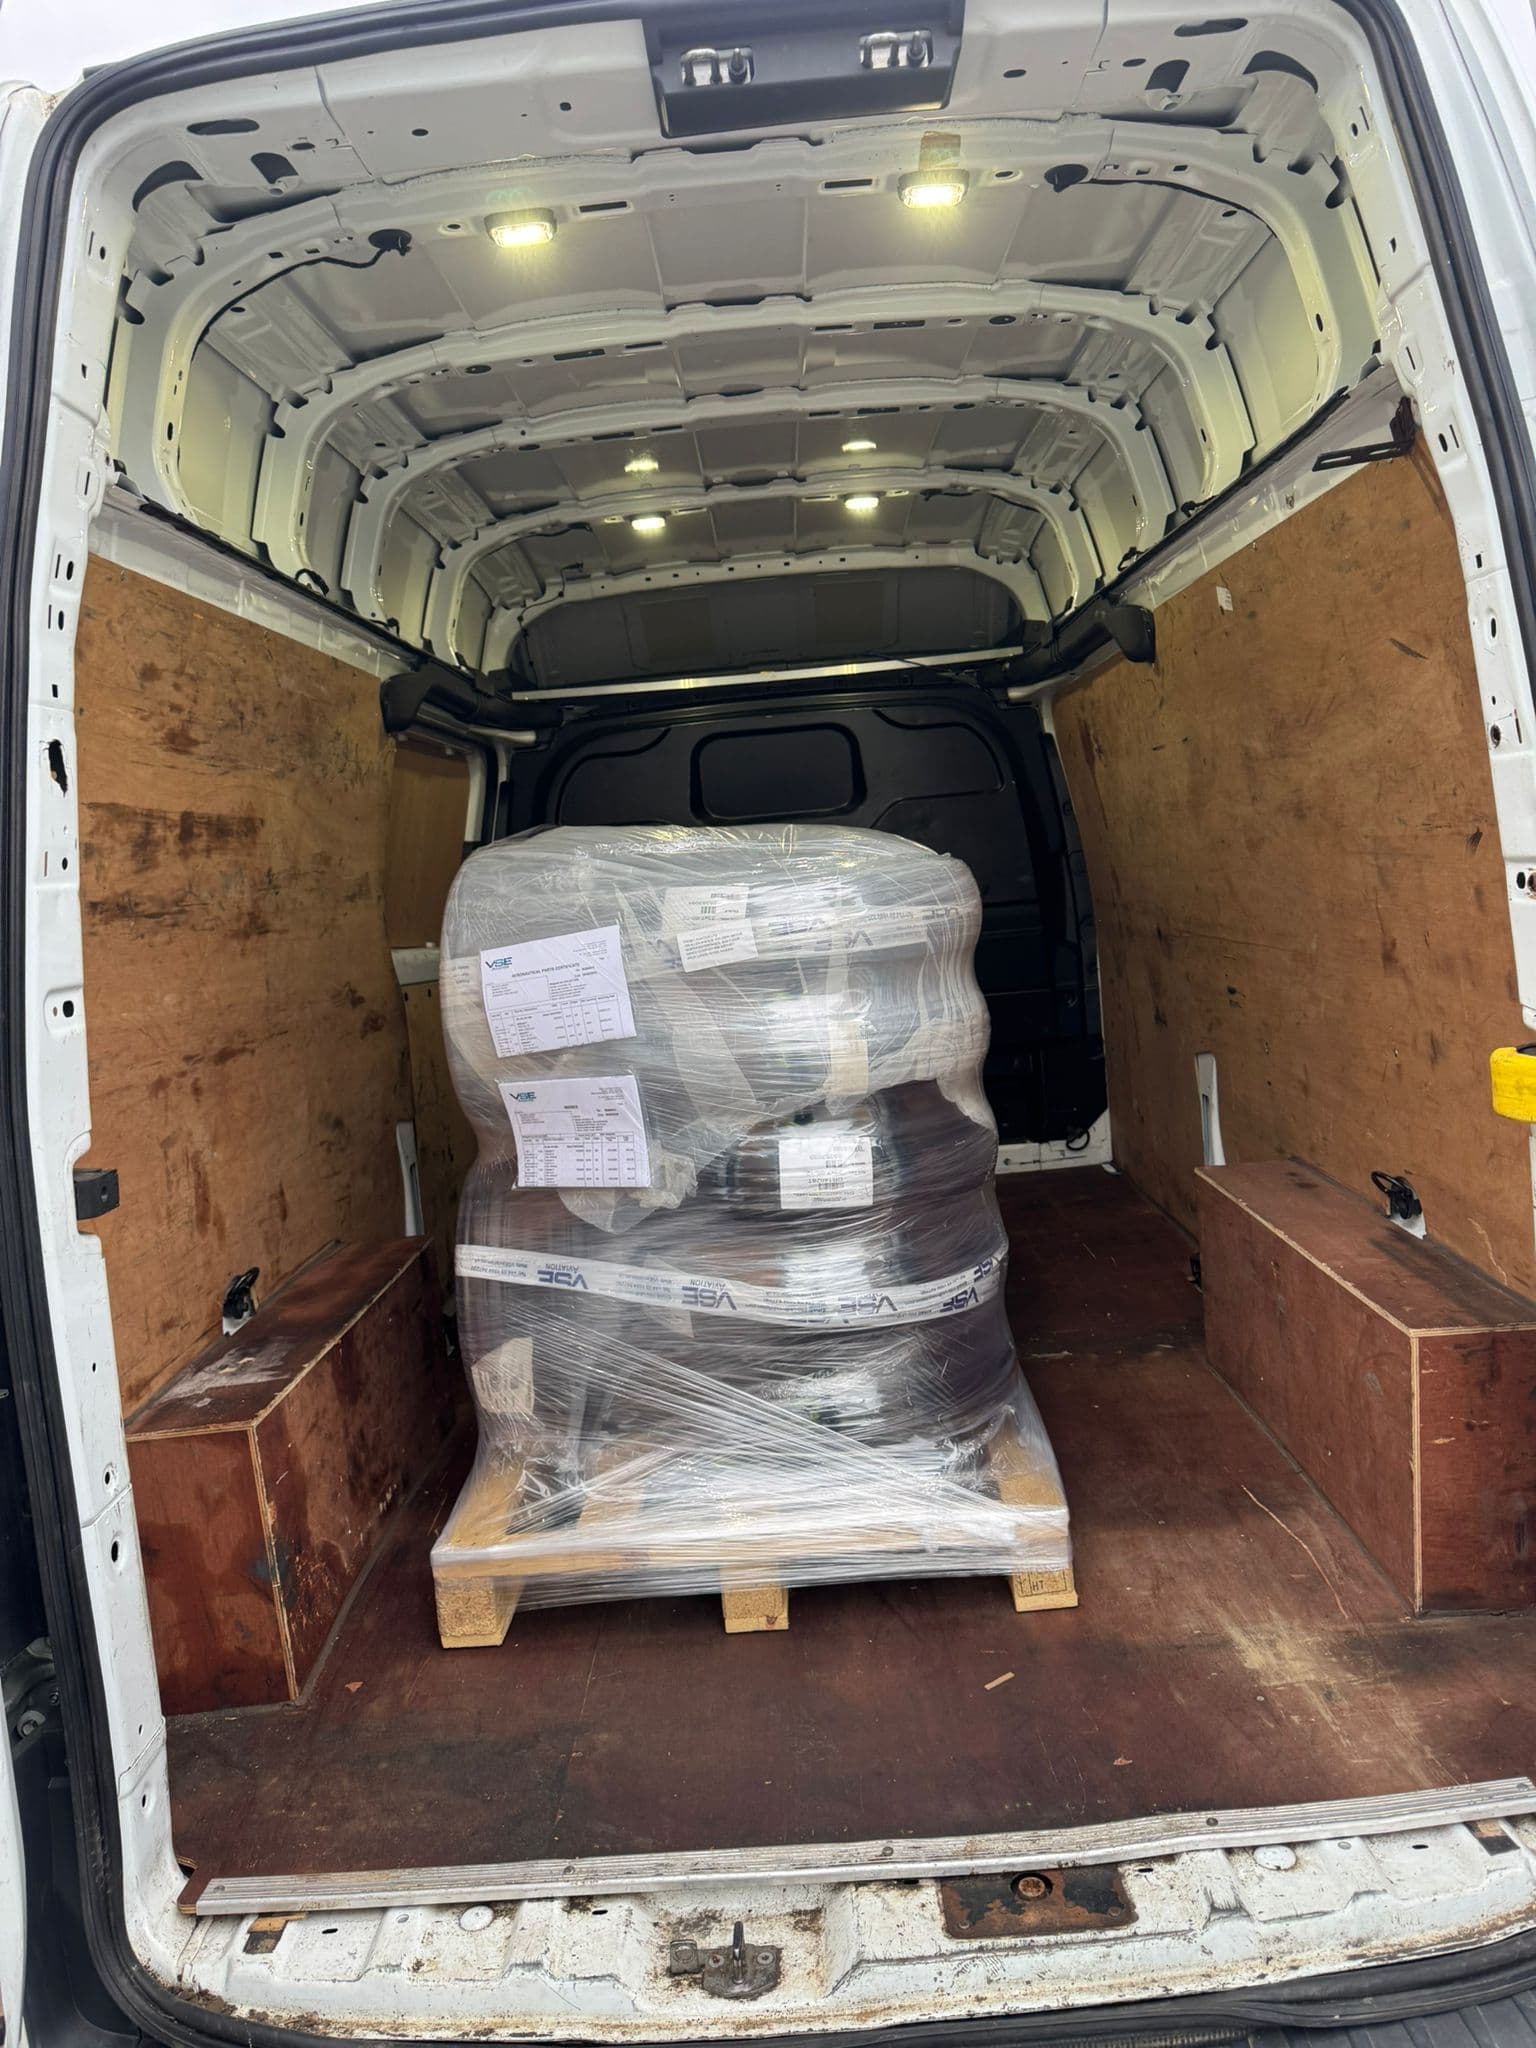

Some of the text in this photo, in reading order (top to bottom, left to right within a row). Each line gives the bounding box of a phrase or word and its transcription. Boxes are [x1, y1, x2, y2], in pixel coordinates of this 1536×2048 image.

[485, 956, 512, 969] VSE
[509, 1091, 537, 1101] VSE
[545, 1262, 580, 1273] AVIATION
[689, 1278, 726, 1289] AVIATION
[681, 1285, 737, 1311] VSE
[1031, 1579, 1044, 1592] HT
